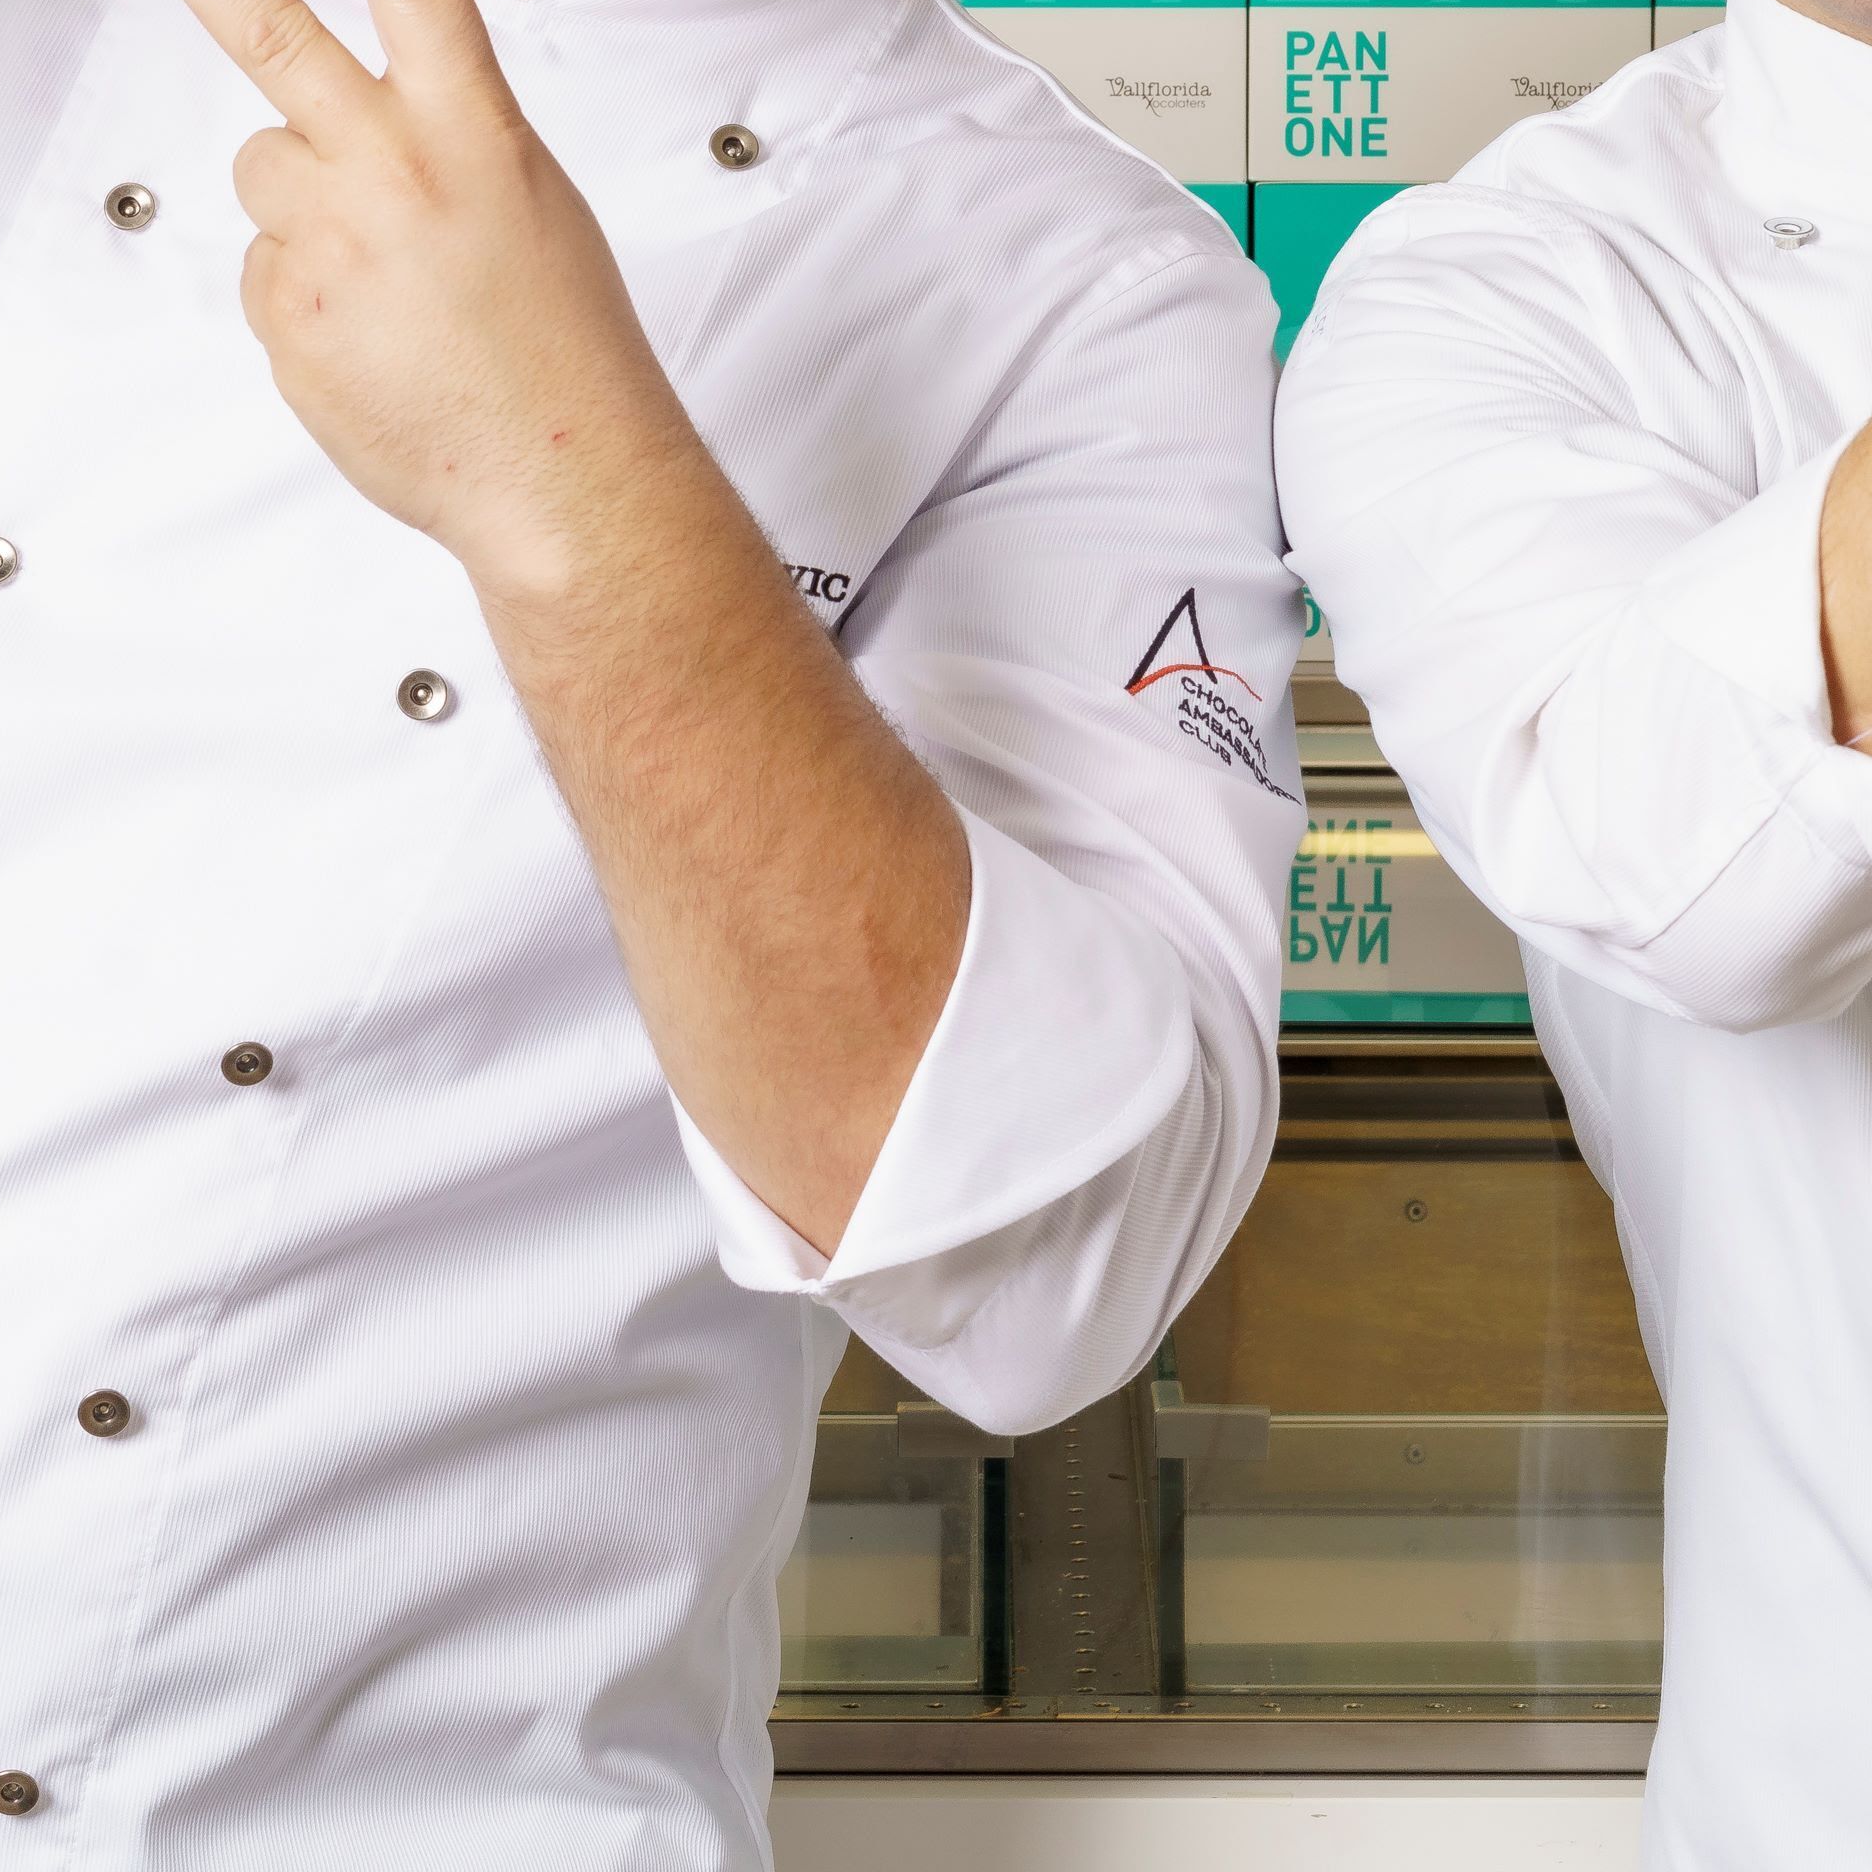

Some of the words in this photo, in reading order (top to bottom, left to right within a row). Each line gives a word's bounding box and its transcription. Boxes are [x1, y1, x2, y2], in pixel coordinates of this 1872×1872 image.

[1286, 31, 1386, 70] PAN
[1105, 77, 1211, 97] Vallflorida
[1142, 95, 1205, 117] Xocolaters
[1286, 75, 1389, 113] ETT
[1510, 77, 1604, 97] Vallflori
[1285, 117, 1388, 157] ONE
[1179, 720, 1231, 766] CLUB
